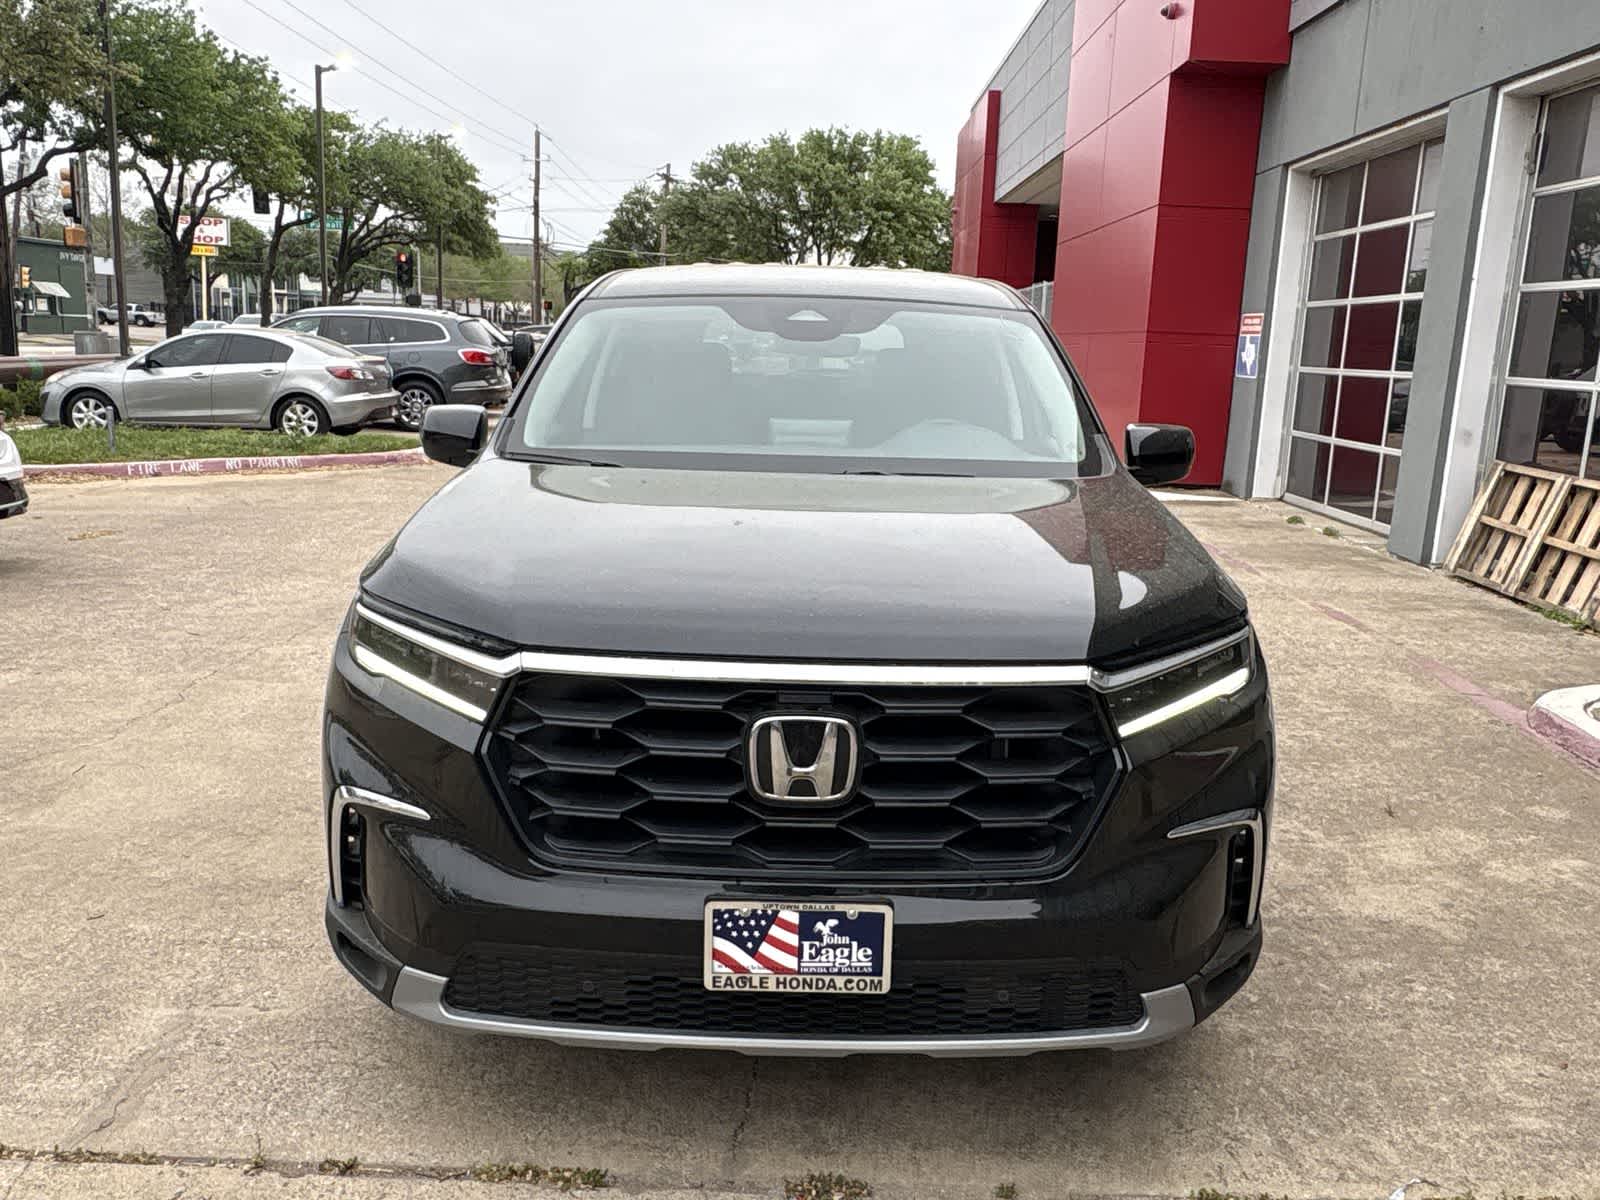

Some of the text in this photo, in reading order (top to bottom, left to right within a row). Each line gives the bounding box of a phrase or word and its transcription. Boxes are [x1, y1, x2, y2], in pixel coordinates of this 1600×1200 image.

[180, 216, 224, 226] SOP
[193, 235, 224, 244] HOP
[128, 457, 303, 475] FIRE LANE NO PARKING
[821, 933, 851, 947] John
[800, 940, 873, 968] Eagle
[712, 975, 884, 992] EAGLE HONDA.COM
